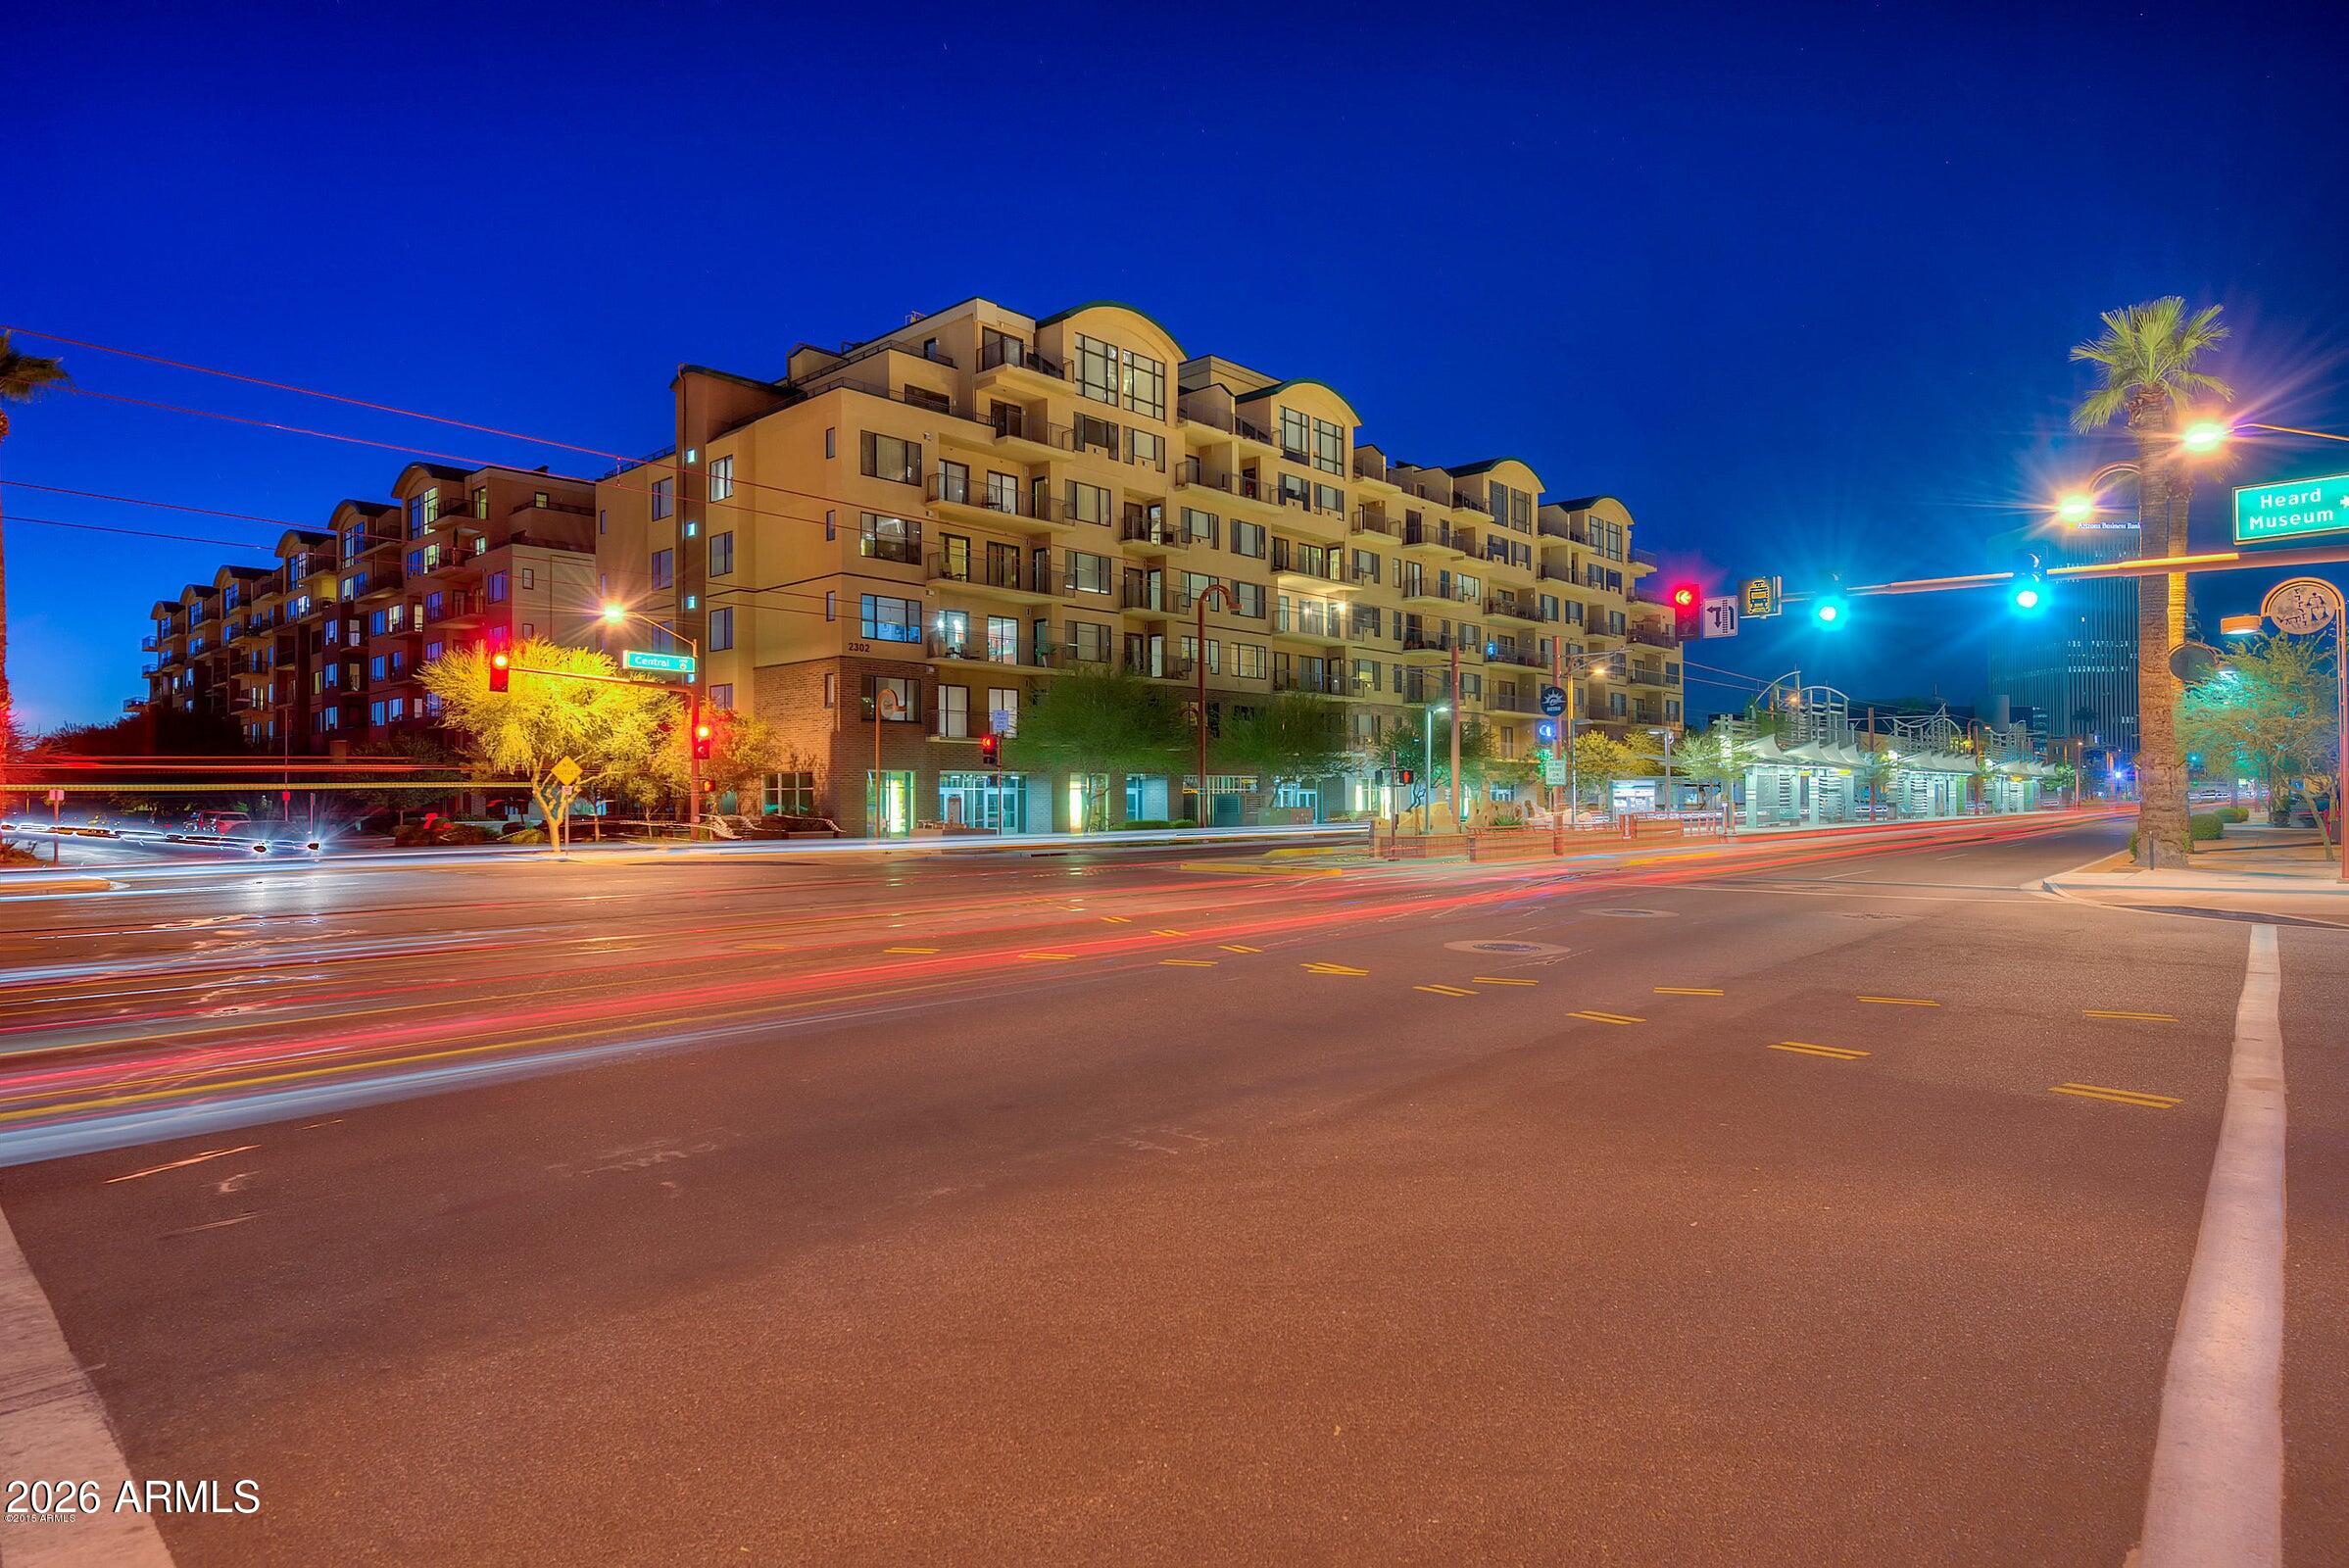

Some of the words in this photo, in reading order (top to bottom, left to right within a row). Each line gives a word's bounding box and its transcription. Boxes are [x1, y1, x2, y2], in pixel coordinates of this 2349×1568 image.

[2260, 488, 2322, 509] Heard
[2249, 510, 2333, 530] Museum
[848, 642, 870, 653] 2302
[634, 656, 670, 667] Central
